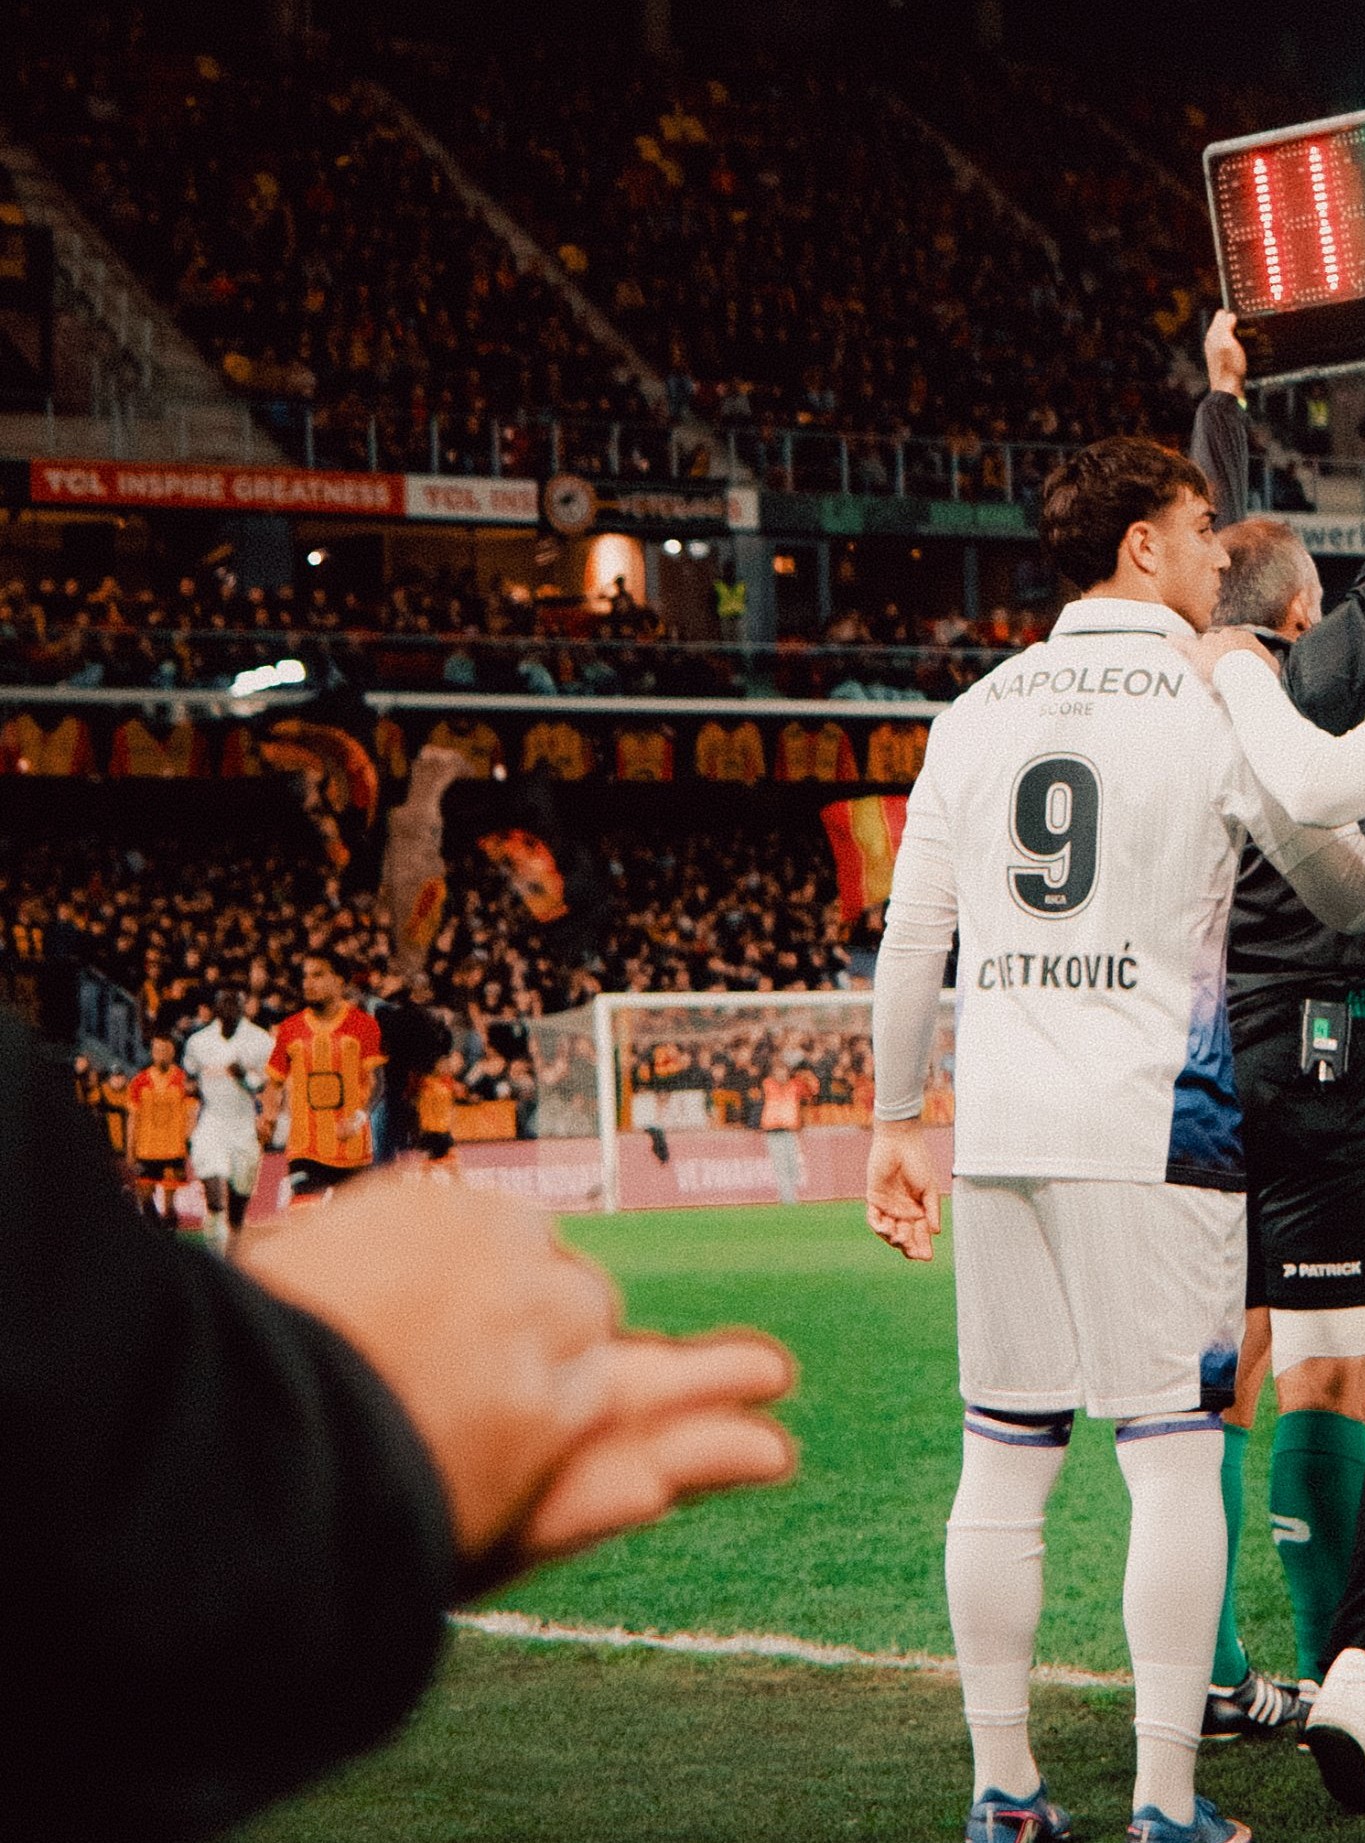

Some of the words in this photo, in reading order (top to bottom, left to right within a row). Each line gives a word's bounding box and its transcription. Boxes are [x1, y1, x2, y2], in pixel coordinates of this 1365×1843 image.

[1253, 144, 1340, 301] 11
[985, 667, 1184, 705] NAPOLEON
[1006, 750, 1104, 920] 9
[1299, 1260, 1362, 1278] PATRICK
